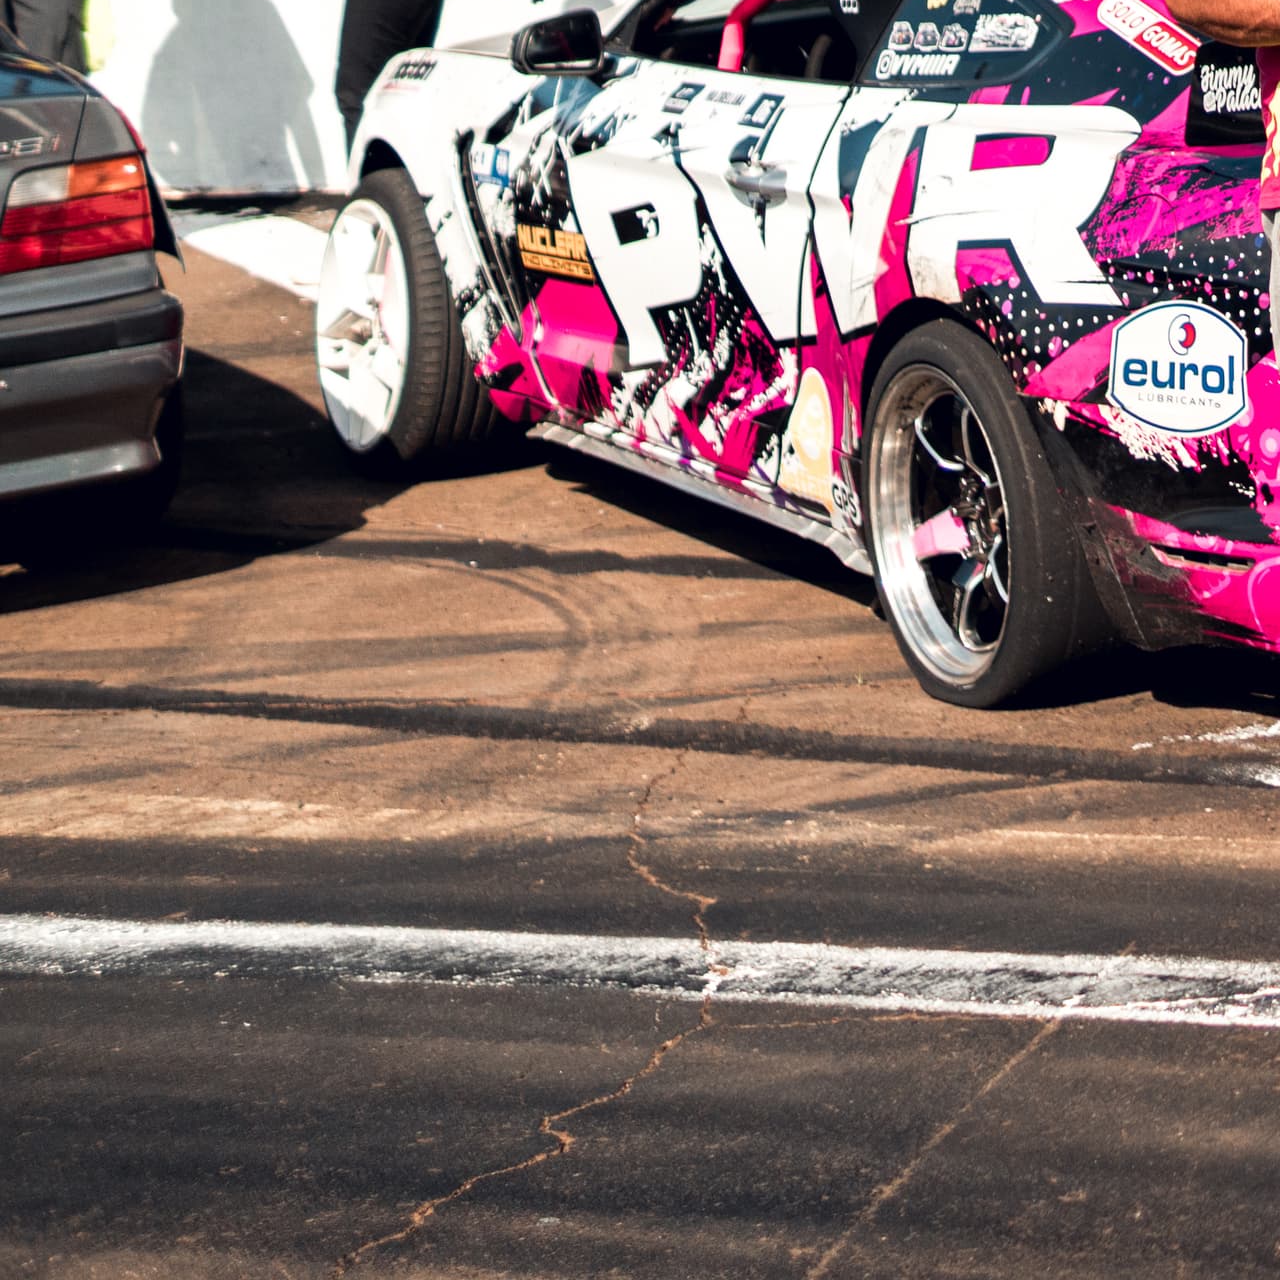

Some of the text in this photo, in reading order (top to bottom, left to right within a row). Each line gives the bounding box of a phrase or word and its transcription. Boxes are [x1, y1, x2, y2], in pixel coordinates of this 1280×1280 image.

[1107, 0, 1196, 66] SOLO GOMAS
[1200, 63, 1256, 93] Jimmy
[517, 224, 589, 262] NUCLEAR
[547, 257, 593, 277] LIMITS
[1123, 355, 1235, 395] eurol
[832, 482, 858, 518] GPS
